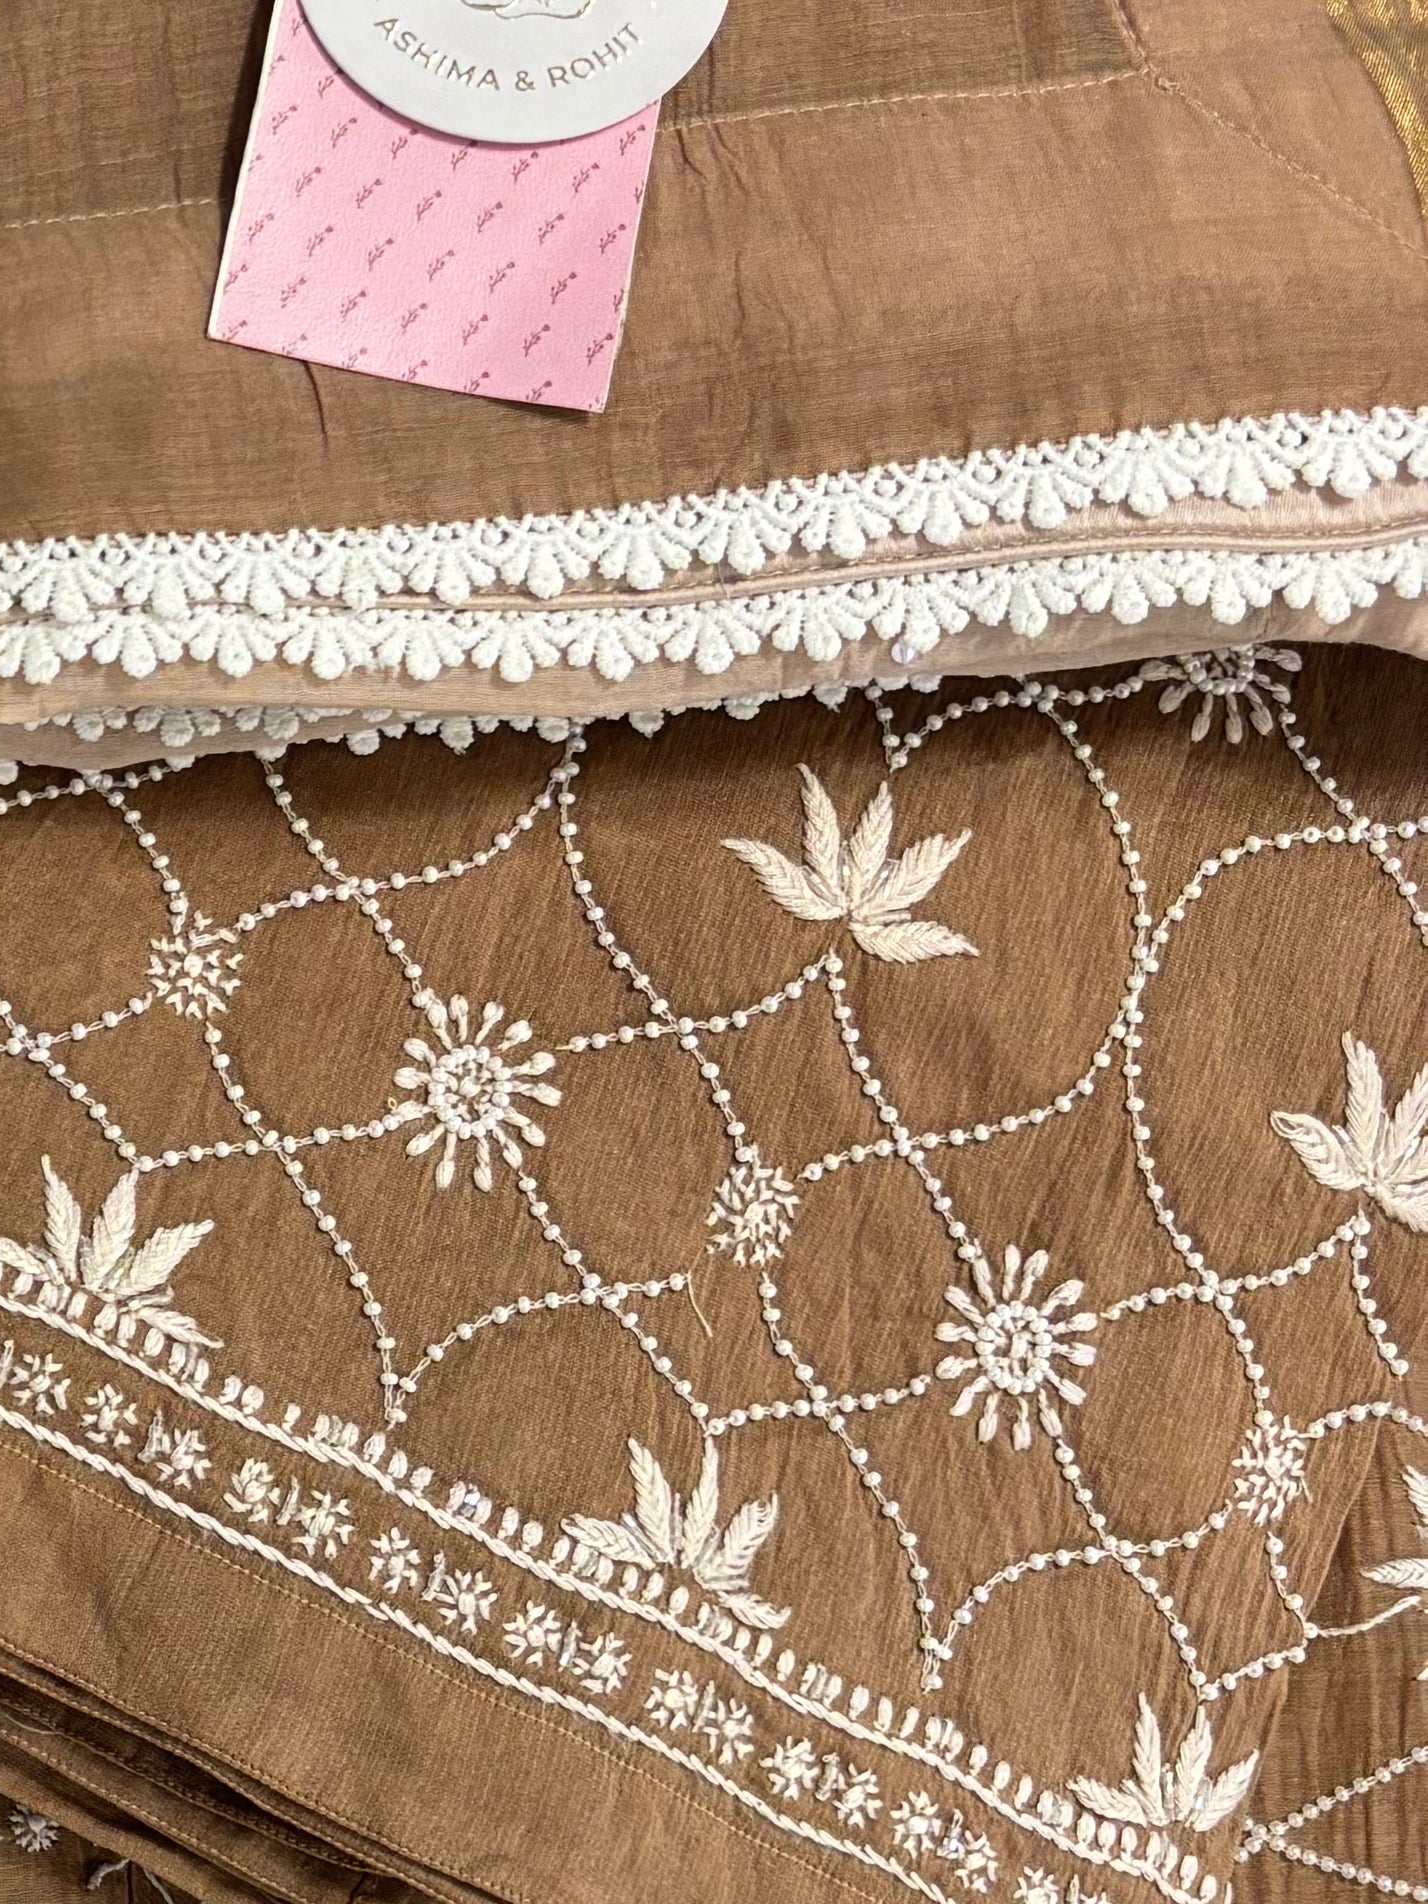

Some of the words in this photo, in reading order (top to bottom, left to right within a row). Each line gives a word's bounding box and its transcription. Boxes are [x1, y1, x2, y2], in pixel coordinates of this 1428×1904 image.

[373, 17, 500, 91] ASHIMA
[514, 70, 536, 92] &
[546, 22, 640, 88] ROHIT
